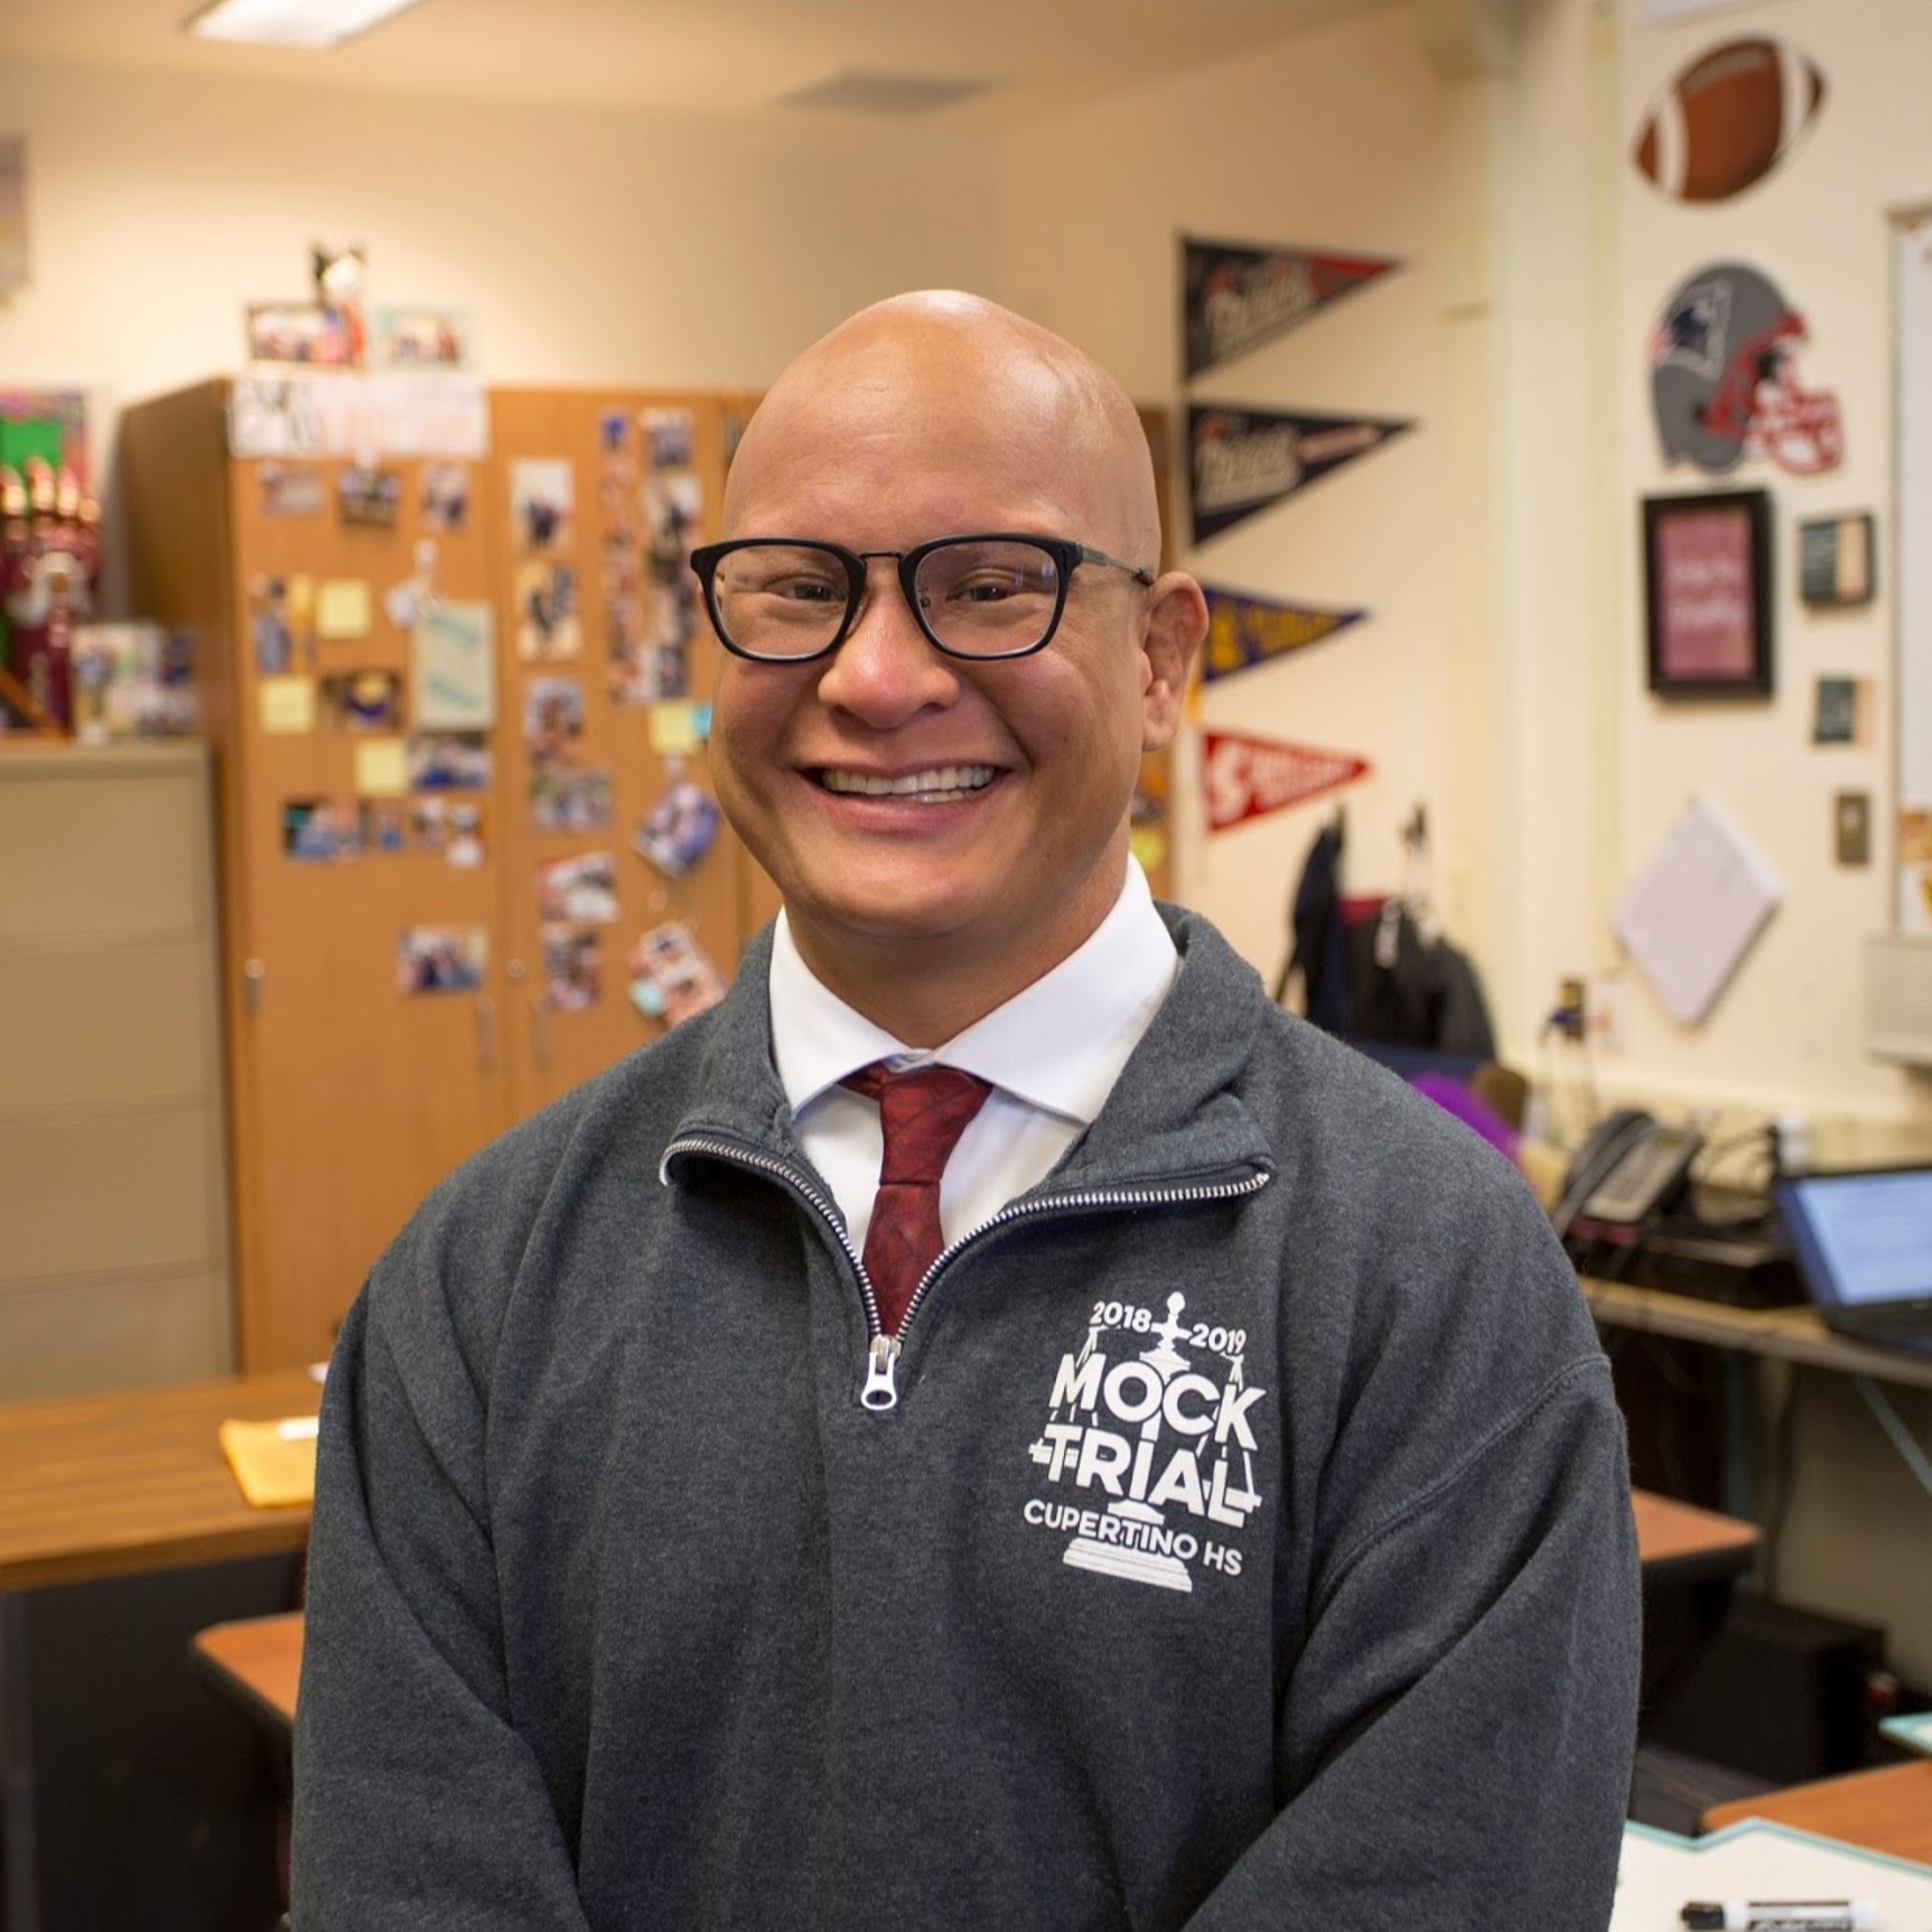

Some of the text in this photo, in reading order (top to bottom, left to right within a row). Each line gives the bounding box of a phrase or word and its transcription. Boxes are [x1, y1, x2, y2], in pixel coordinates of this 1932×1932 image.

[1090, 1302, 1246, 1353] 2018 2019
[1048, 1353, 1267, 1450] MOCK
[1044, 1424, 1245, 1528] TRIAL
[1024, 1499, 1244, 1576] CUPERTINO HS
